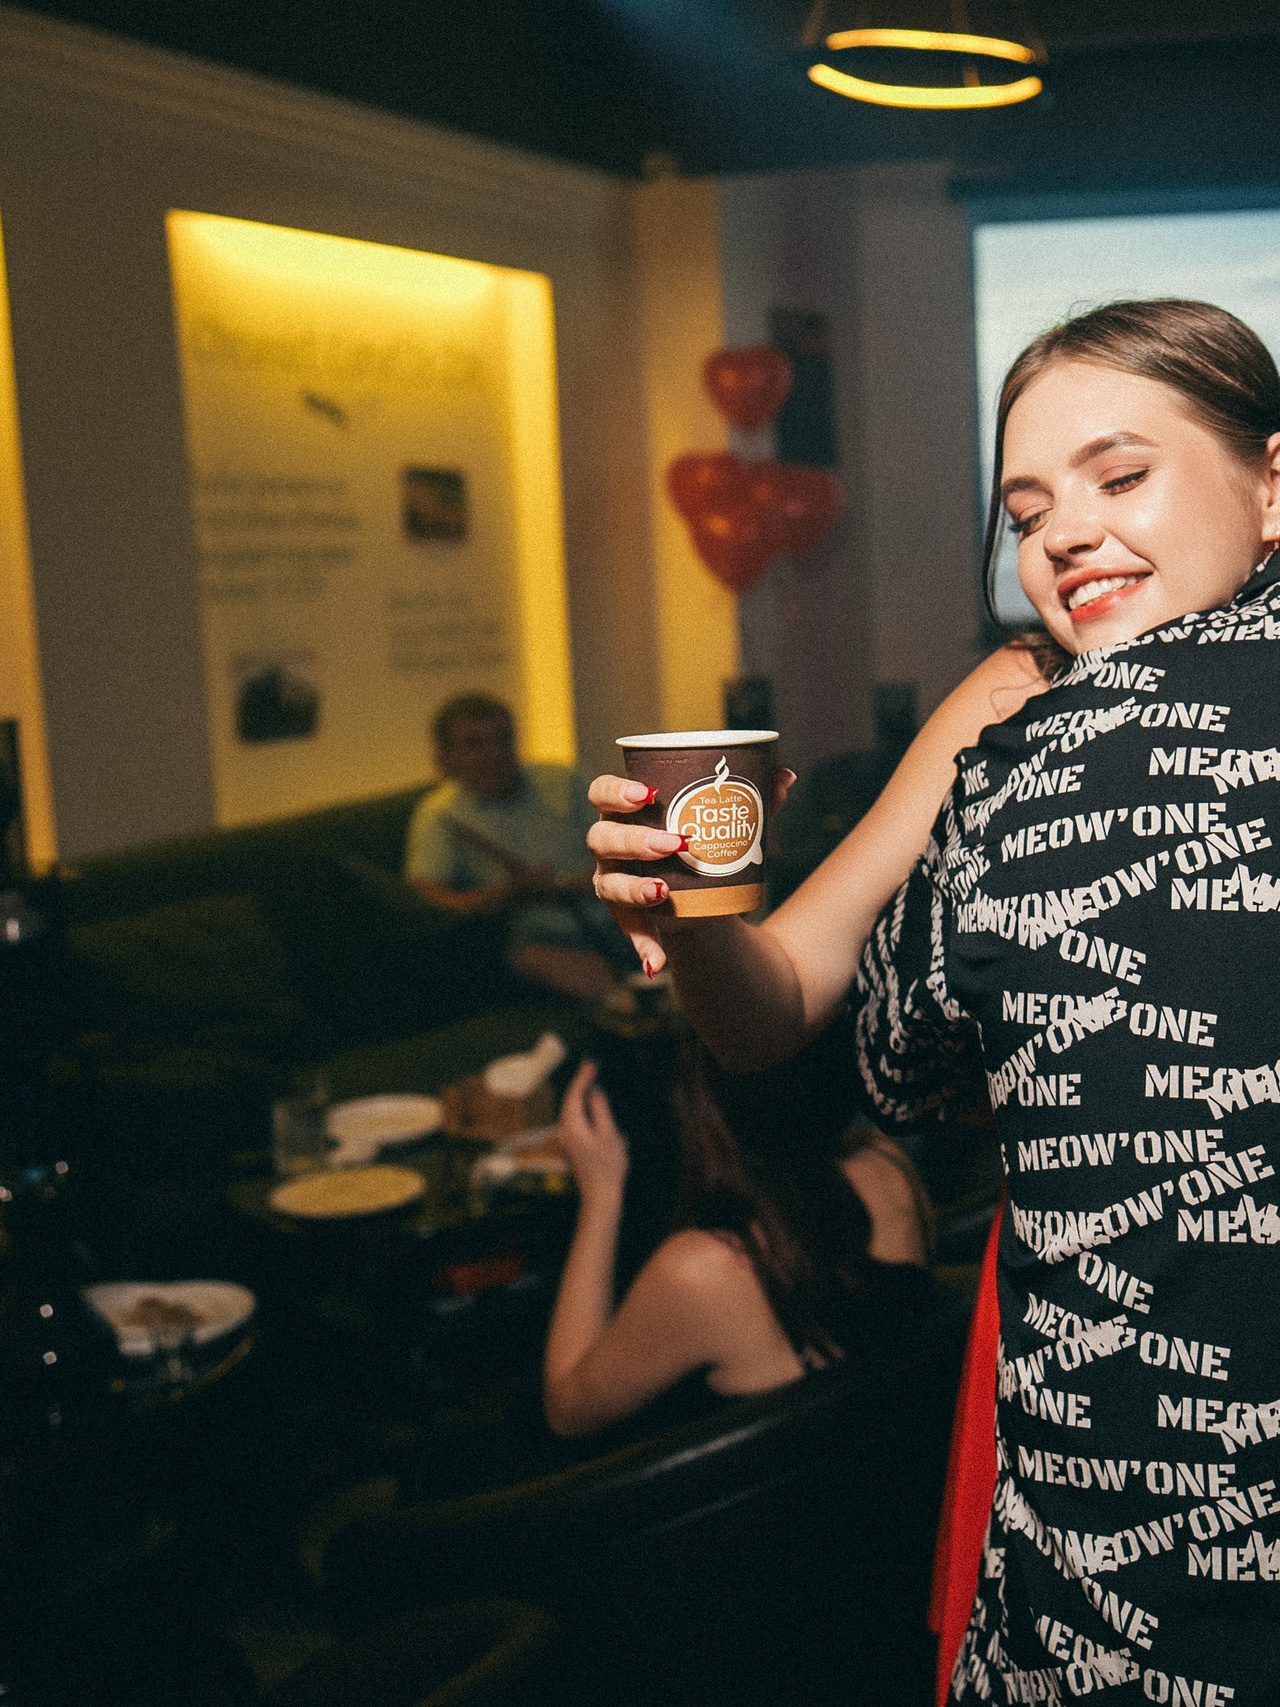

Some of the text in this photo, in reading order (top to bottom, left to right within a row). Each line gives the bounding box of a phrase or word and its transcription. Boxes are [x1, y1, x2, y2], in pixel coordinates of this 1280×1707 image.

[700, 794, 742, 805] Tea Latte
[690, 803, 749, 824] Taste
[681, 820, 756, 842] Quality
[1001, 803, 1227, 863] MEOW'ONE
[693, 840, 748, 851] Cappuccino
[707, 849, 738, 859] Coffee
[1017, 1129, 1225, 1172] MEOW'ONE
[1018, 1445, 1237, 1497] MEOW'ONE
